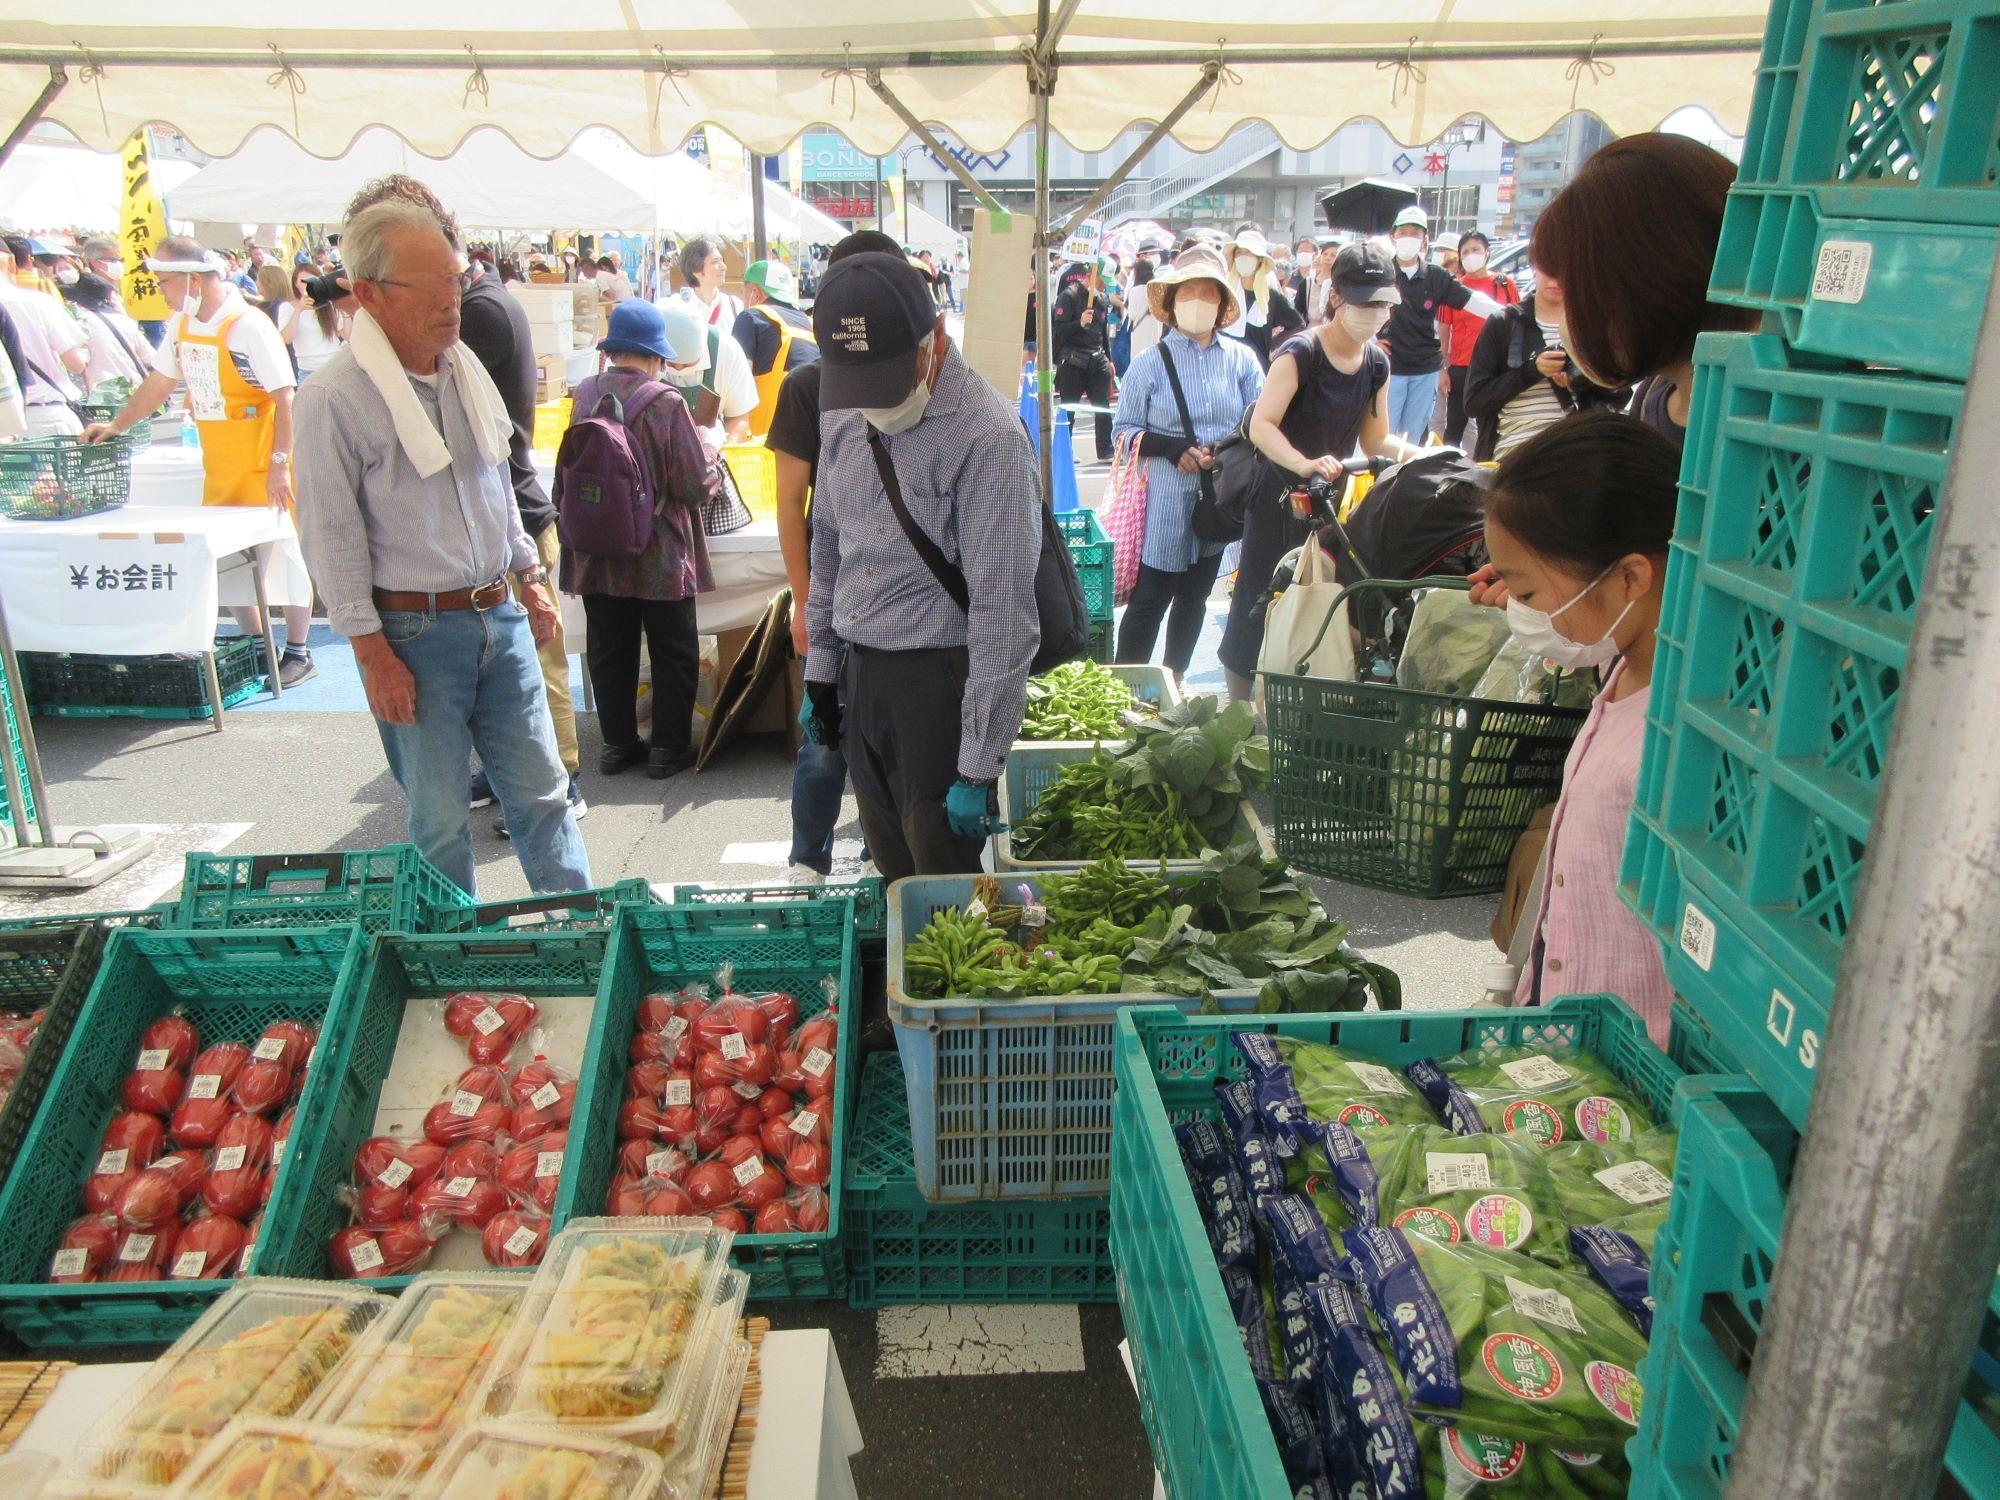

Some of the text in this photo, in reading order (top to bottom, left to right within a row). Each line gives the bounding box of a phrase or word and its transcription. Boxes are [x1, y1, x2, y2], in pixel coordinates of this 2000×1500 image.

[1424, 152, 1446, 176] 本
[817, 170, 875, 178] DANCE SCHOOL
[841, 317, 866, 326] SINCE
[831, 332, 867, 340] California
[1507, 1337, 1545, 1399] 神風香
